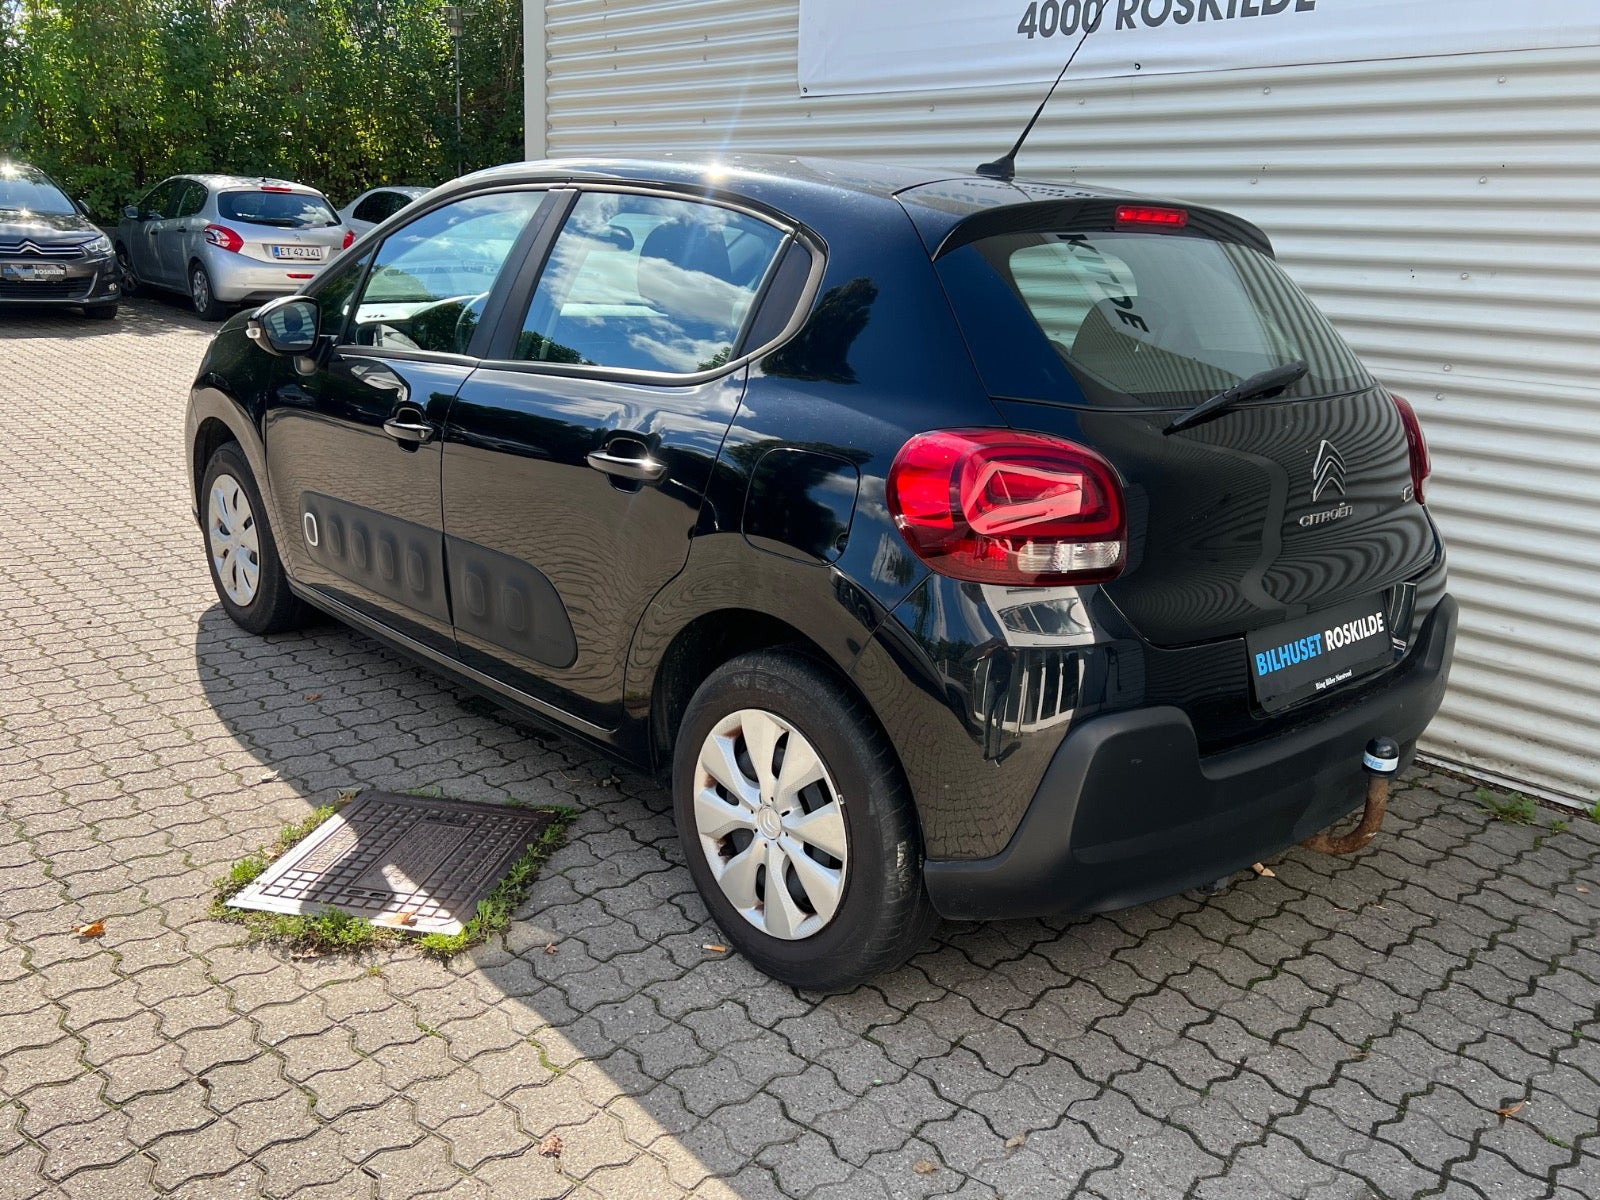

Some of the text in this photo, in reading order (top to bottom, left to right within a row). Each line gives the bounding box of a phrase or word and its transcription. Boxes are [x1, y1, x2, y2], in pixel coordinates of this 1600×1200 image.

[1017, 0, 1104, 39] 4000
[280, 247, 320, 257] ET 42 141
[1255, 611, 1385, 676] BILHUSET ROSKILDE
